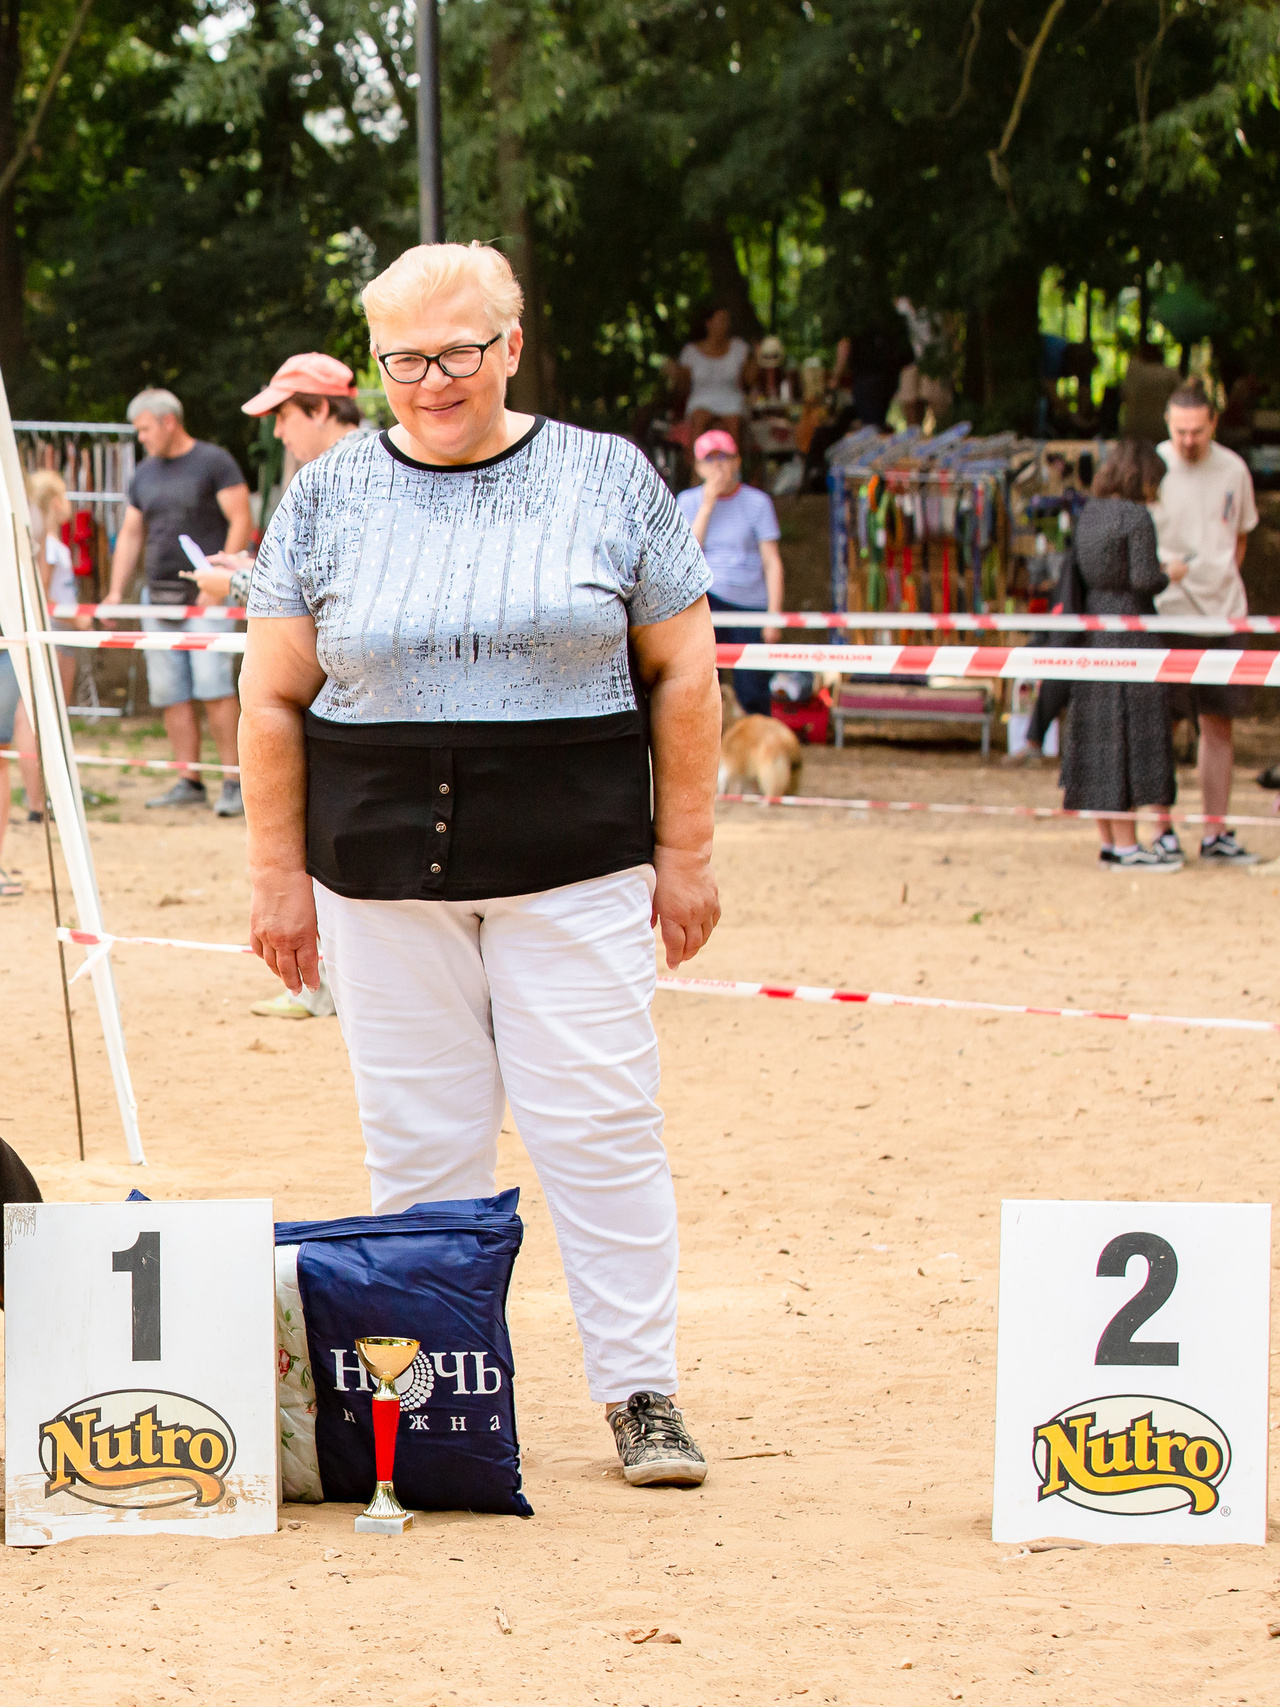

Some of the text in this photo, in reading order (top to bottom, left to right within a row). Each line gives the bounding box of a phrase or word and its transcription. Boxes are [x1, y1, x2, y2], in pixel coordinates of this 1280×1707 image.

[112, 1231, 161, 1362] 1
[1094, 1231, 1180, 1367] 2
[39, 1404, 228, 1507] Nutro
[342, 1408, 502, 1432] нжна
[1033, 1411, 1224, 1515] Nutro
